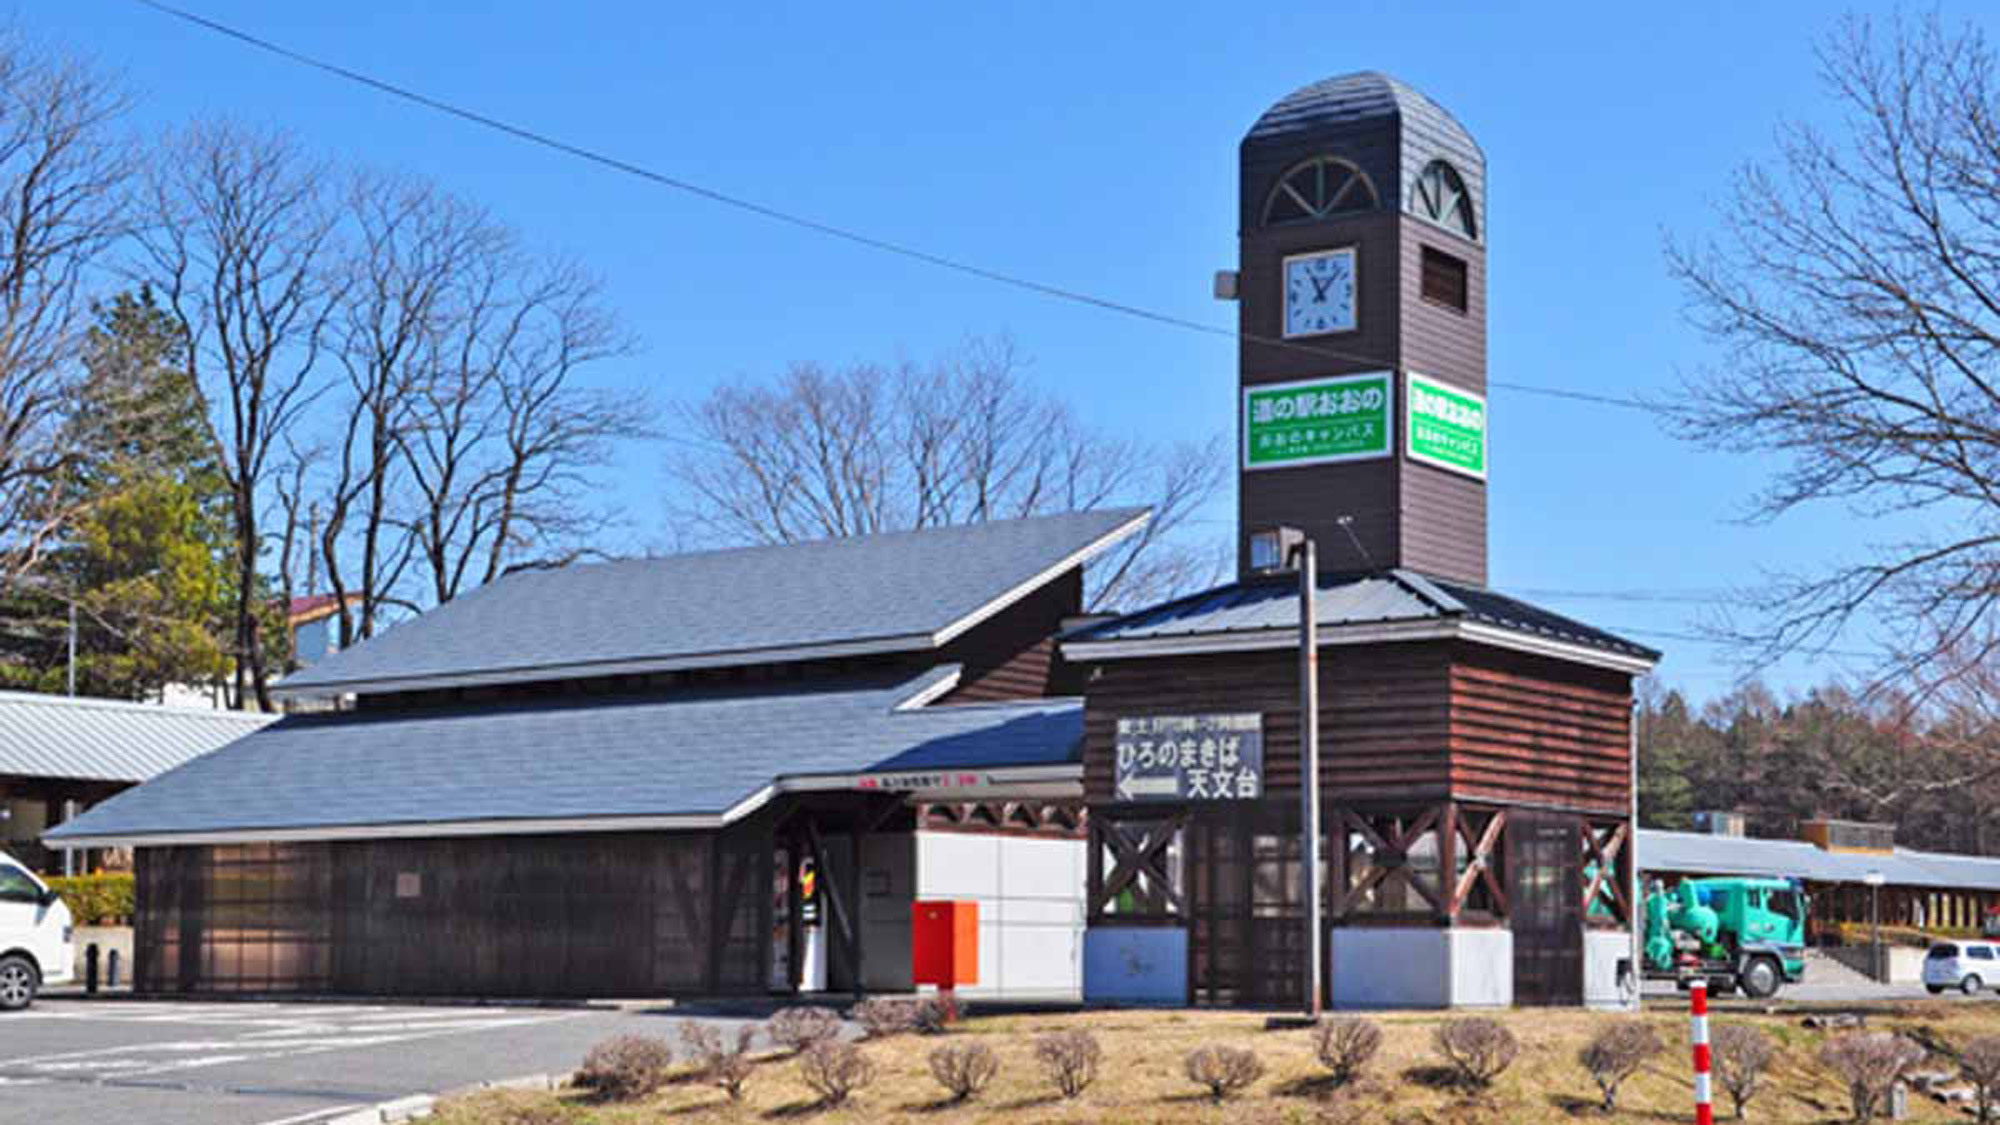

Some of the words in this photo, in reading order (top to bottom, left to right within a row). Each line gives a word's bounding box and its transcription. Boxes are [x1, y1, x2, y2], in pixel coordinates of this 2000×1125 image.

[1118, 736, 1240, 770] ひろのまきば
[1187, 766, 1258, 799] 天文台
